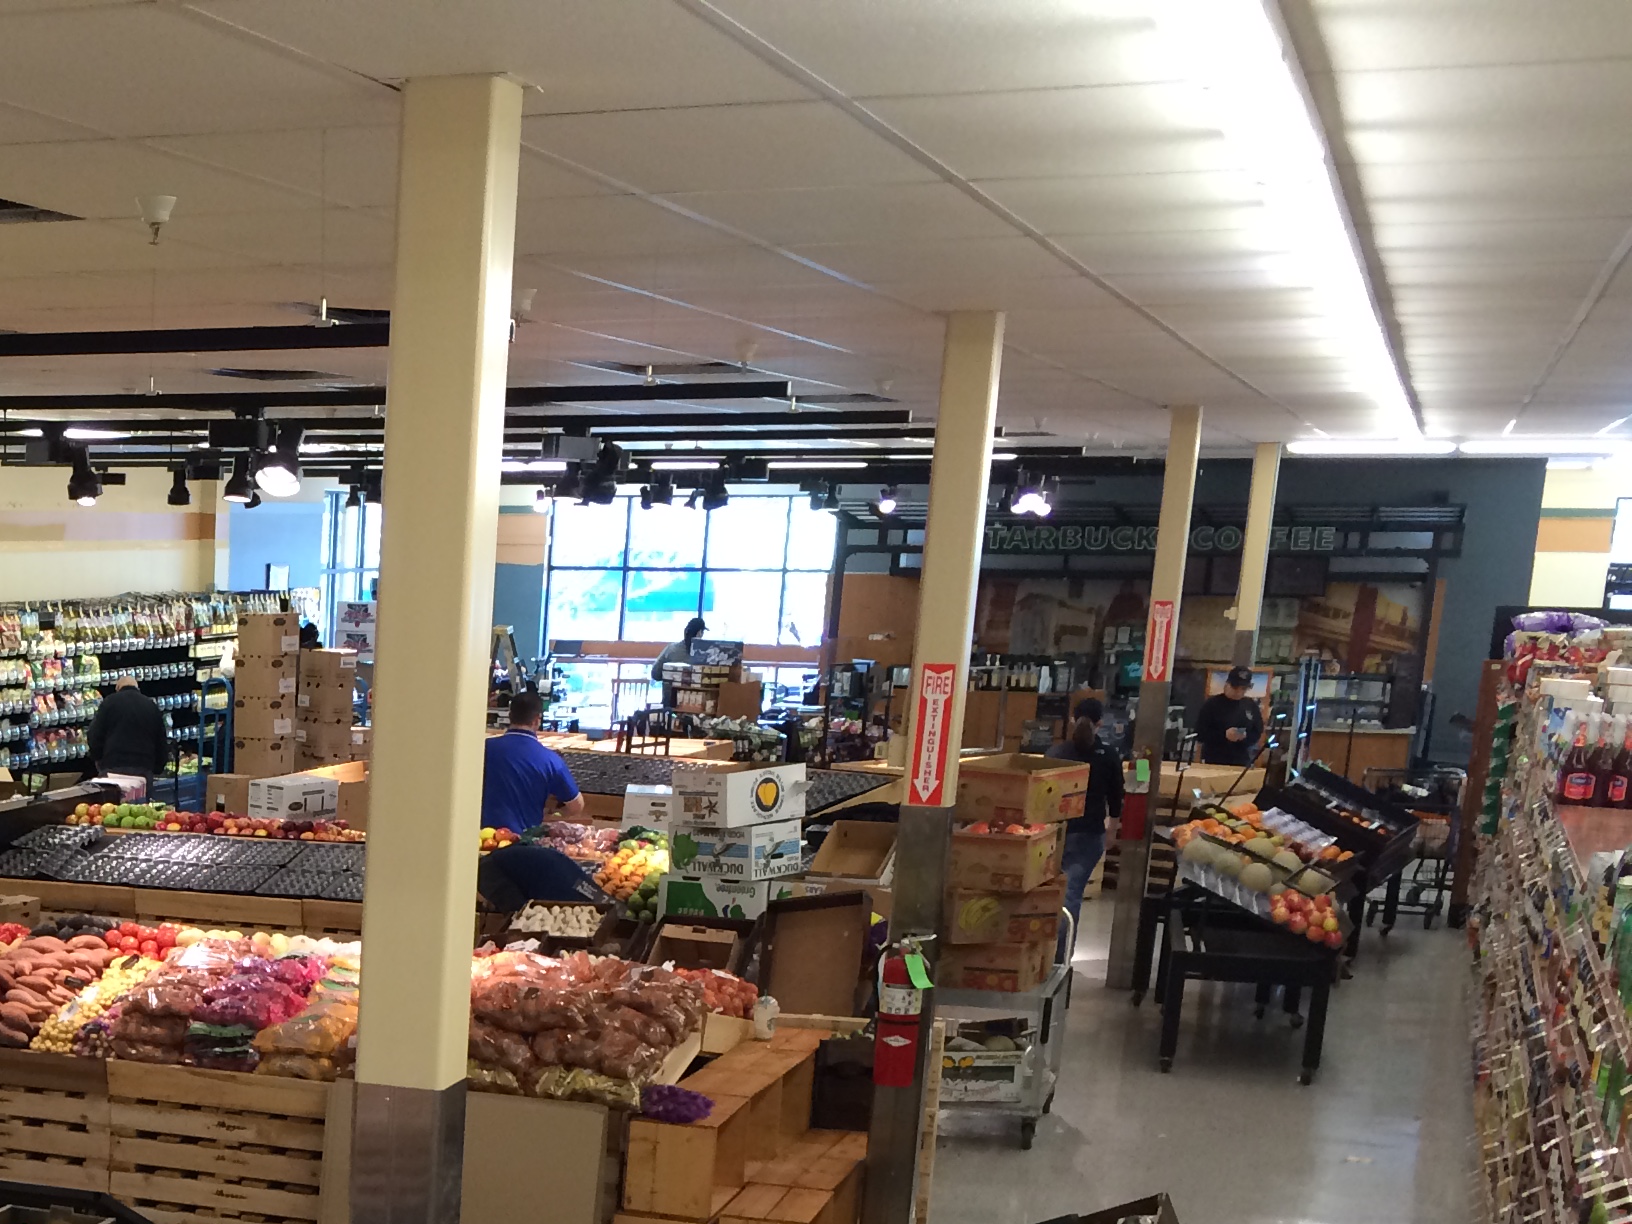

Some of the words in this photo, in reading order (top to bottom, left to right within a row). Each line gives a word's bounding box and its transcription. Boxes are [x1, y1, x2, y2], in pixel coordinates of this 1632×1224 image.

[985, 525, 1159, 550] TARBUCK
[1191, 526, 1337, 550] COFEE
[925, 675, 951, 695] FIRE
[922, 698, 940, 792] EXTINGUISHER
